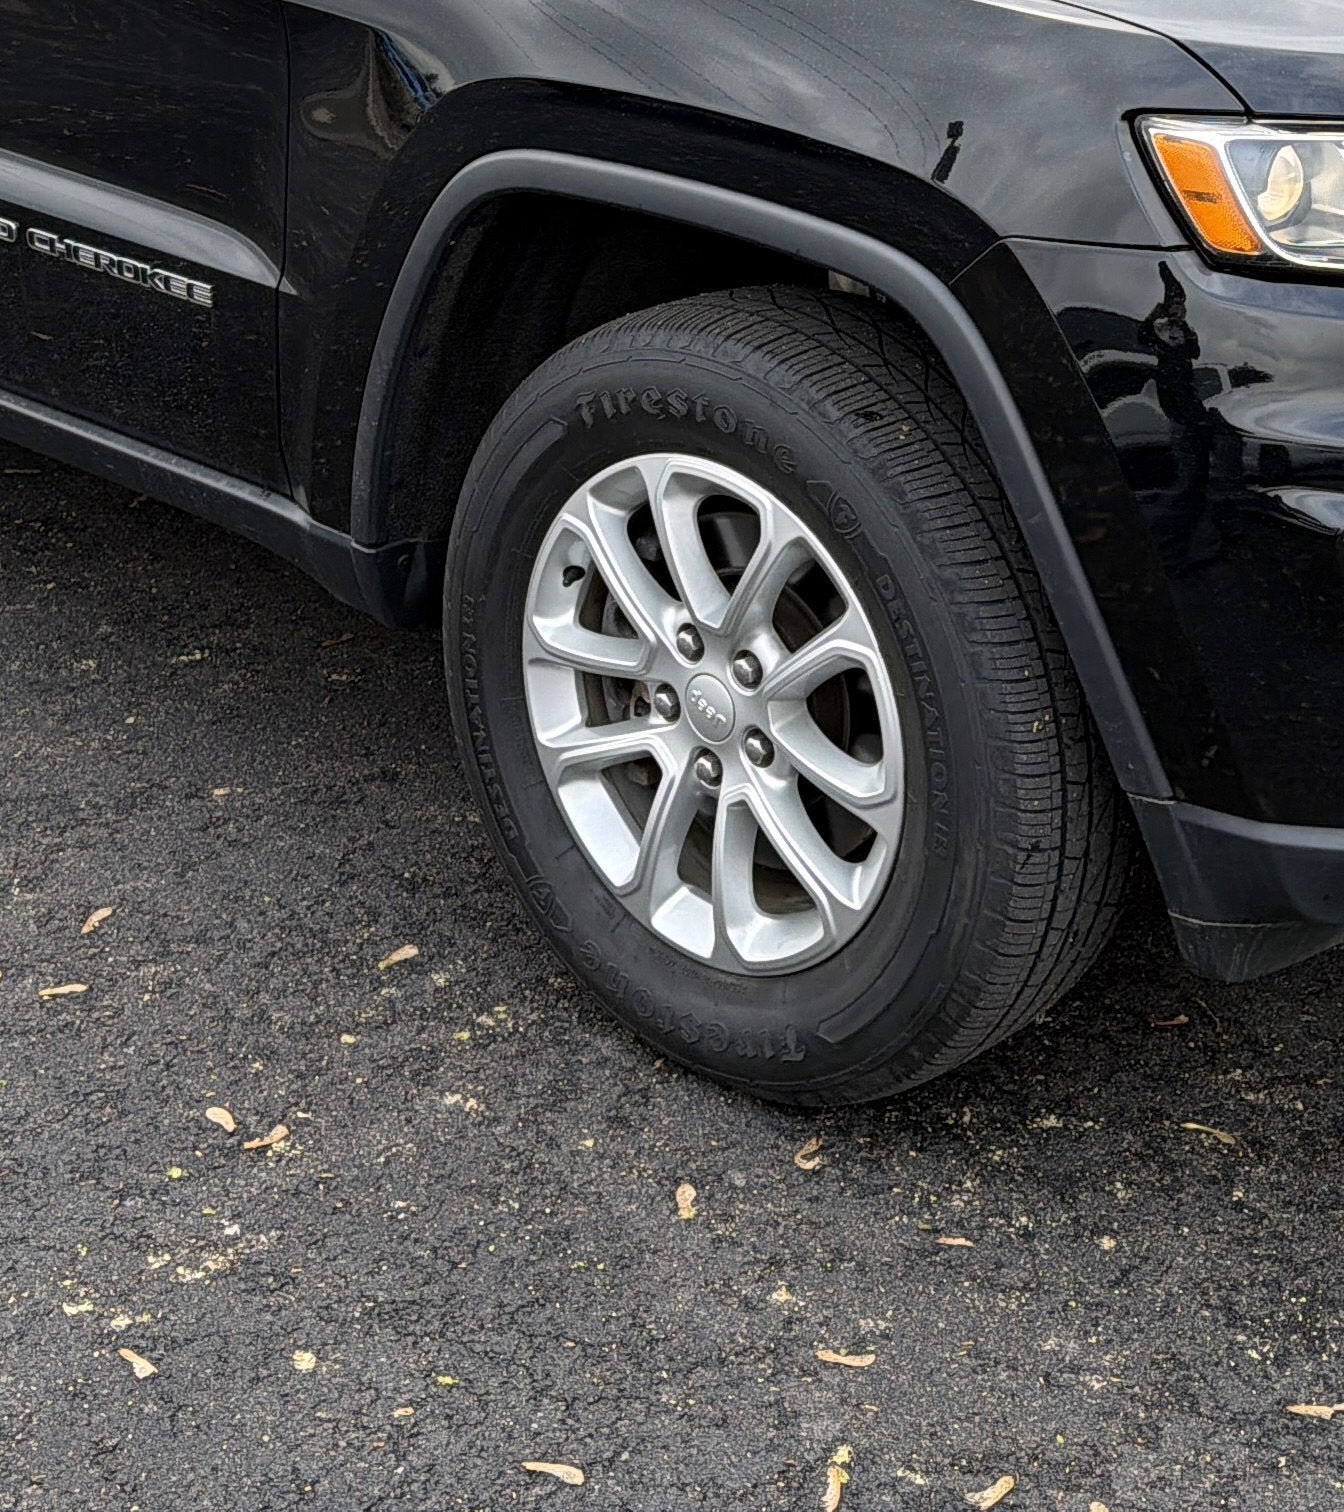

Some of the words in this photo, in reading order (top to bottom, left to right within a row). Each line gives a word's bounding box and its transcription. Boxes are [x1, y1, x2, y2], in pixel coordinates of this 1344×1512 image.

[25, 227, 216, 309] CHEROKEE
[574, 385, 800, 476] Firestone
[690, 689, 728, 728] Jeep
[874, 573, 952, 821] DESTINATION
